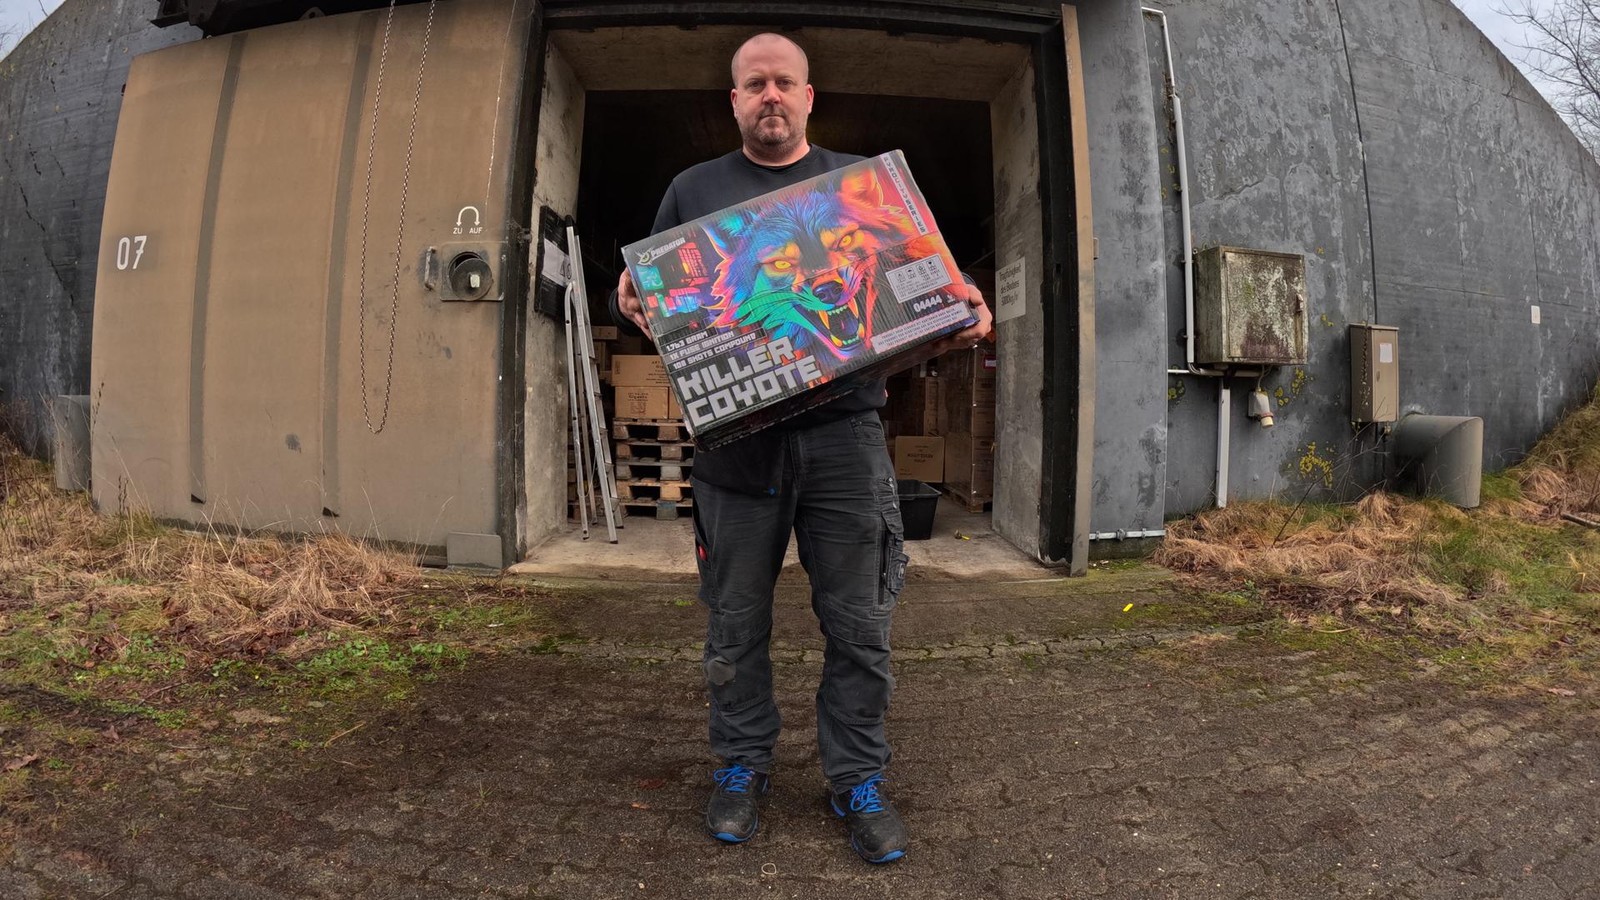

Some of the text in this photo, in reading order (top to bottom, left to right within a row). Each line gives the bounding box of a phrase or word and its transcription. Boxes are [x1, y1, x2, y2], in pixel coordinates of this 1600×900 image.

[453, 226, 483, 235] ZU AUF
[905, 199, 926, 233] SERIES
[117, 235, 147, 270] 07
[650, 237, 686, 258] PREDATOR
[913, 294, 943, 313] 04444
[669, 331, 735, 361] 1X FUSE IGNITION
[685, 331, 708, 346] GRAM
[688, 350, 714, 365] SHOTS
[715, 333, 757, 353] COMPOUND
[677, 336, 797, 400] KILLER
[686, 355, 822, 428] COYOTE
